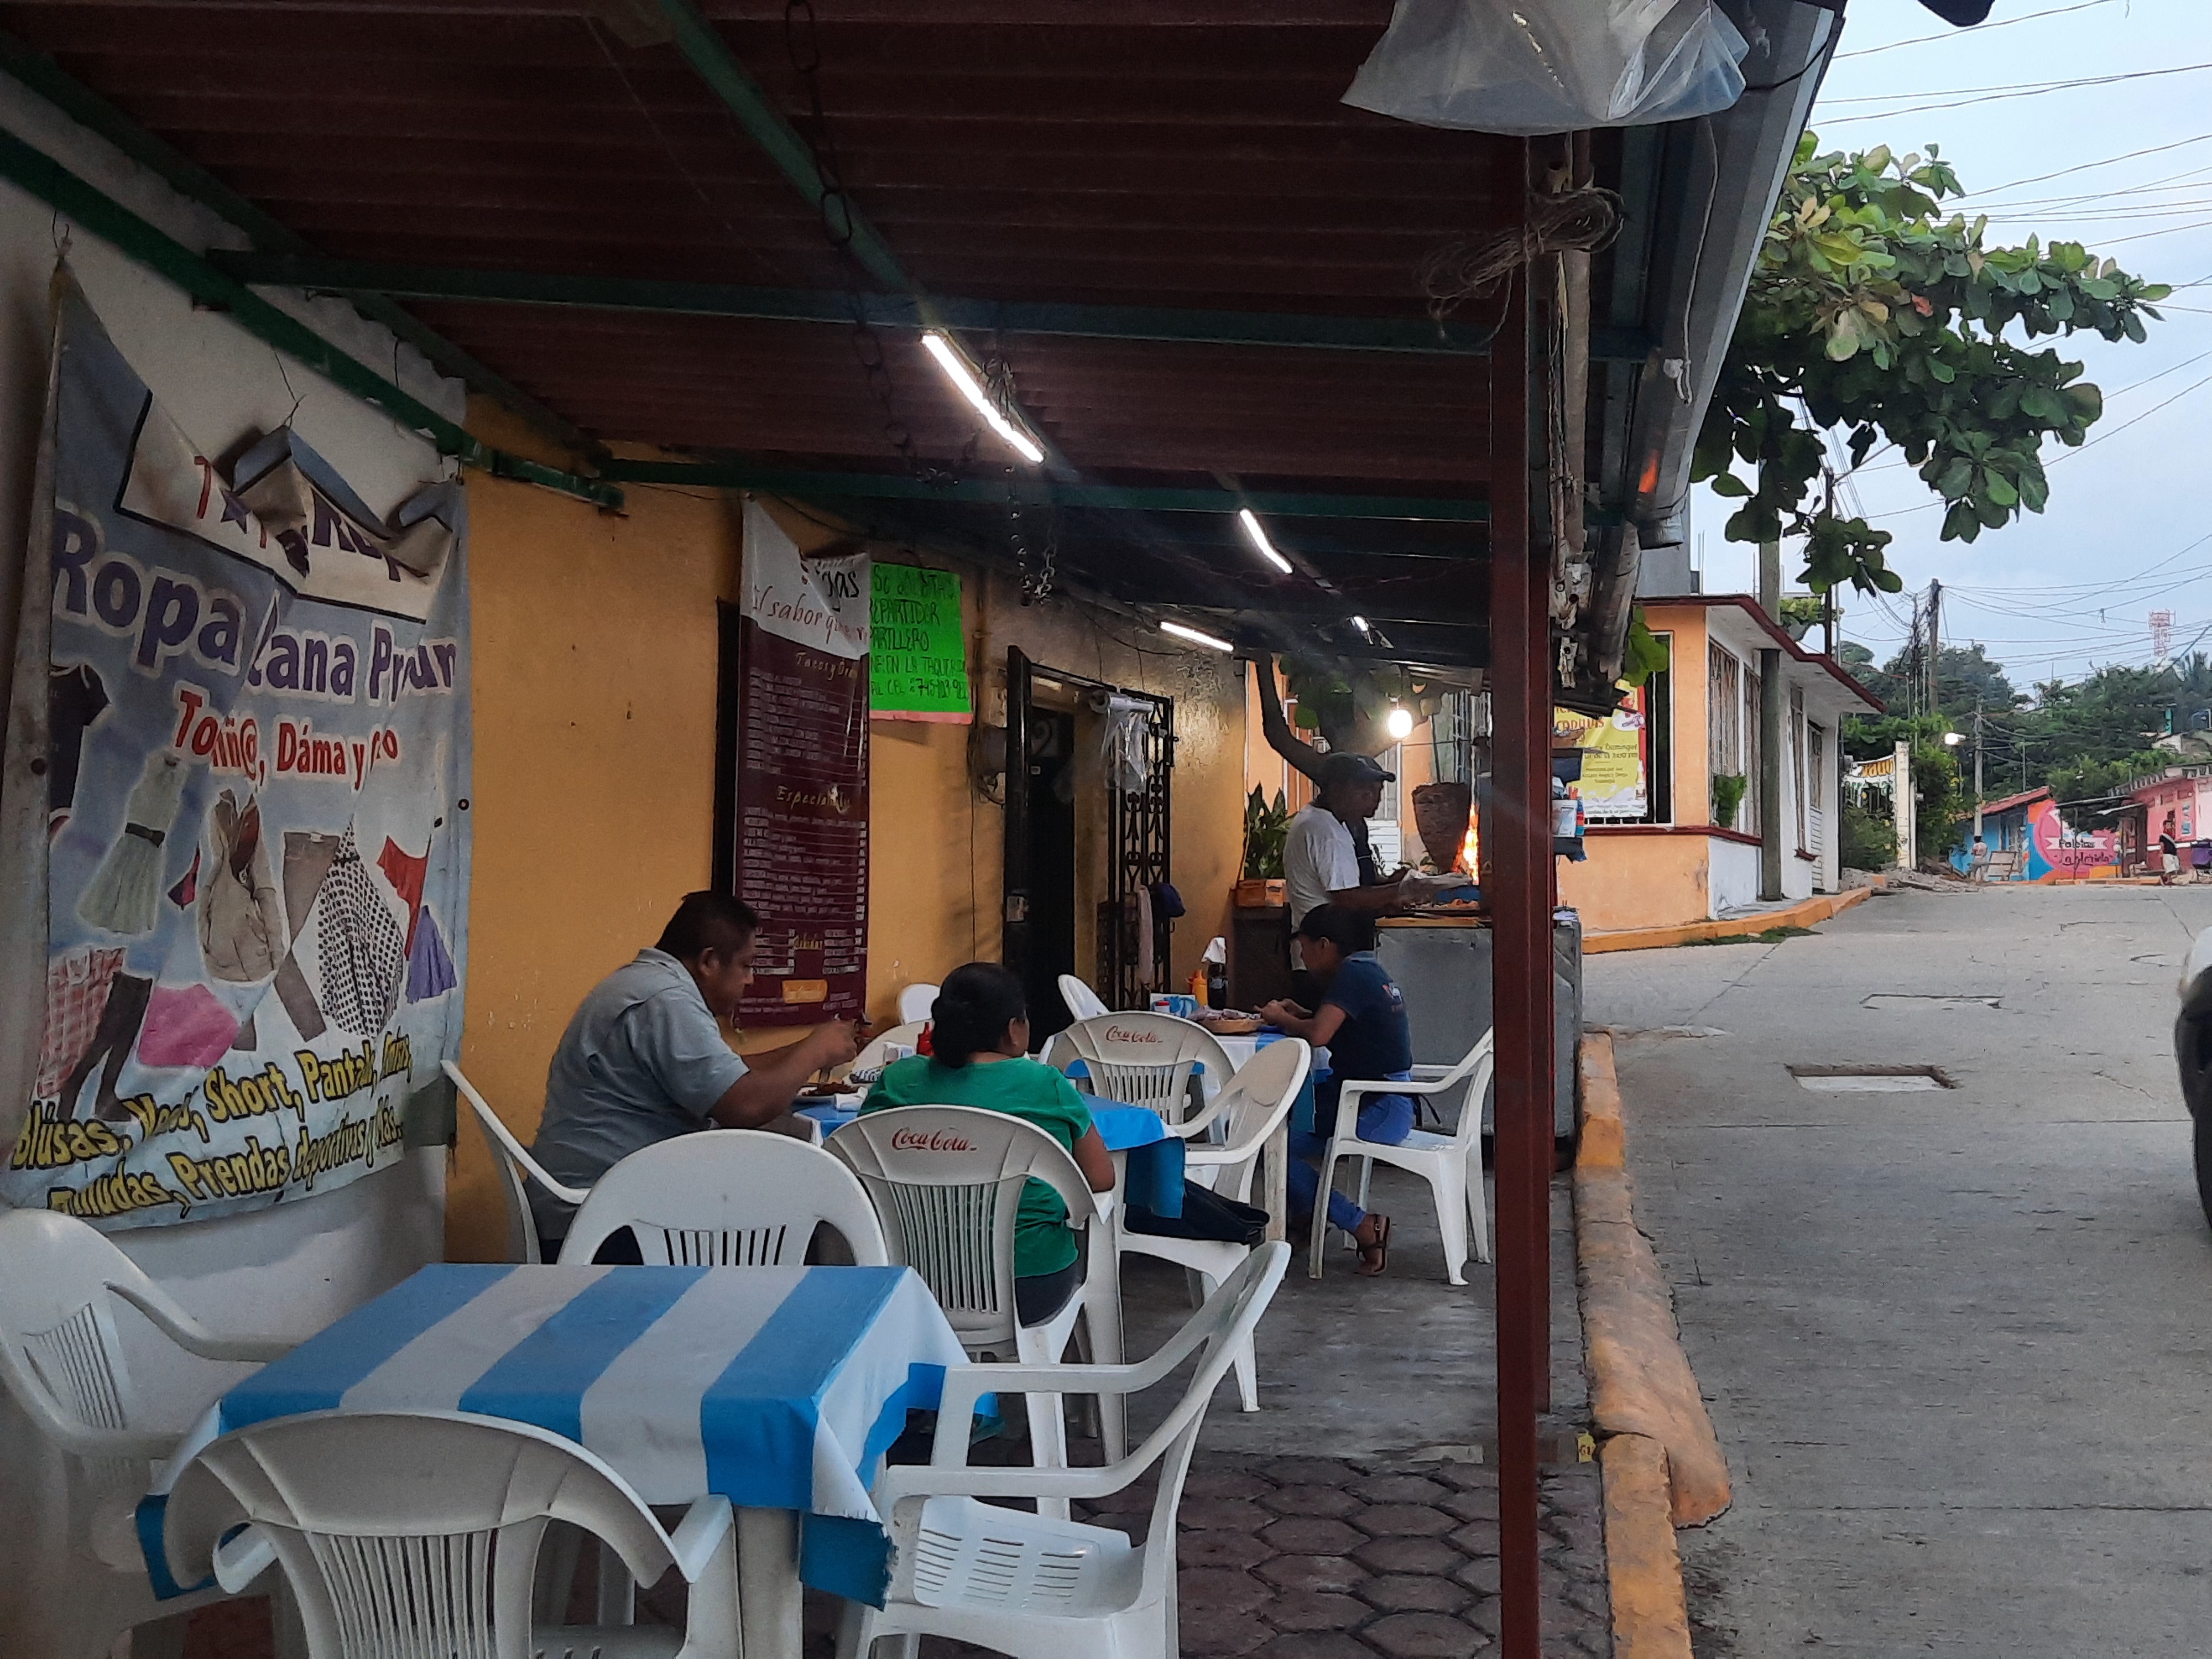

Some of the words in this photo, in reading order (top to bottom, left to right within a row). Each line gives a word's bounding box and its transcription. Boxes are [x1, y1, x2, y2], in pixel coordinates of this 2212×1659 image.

[53, 511, 241, 668] Ropa
[768, 593, 823, 625] sabor
[276, 722, 346, 775] Dáma
[352, 743, 365, 791] y
[204, 1061, 306, 1123] Short,
[165, 1135, 291, 1201] Prendas
[292, 1110, 367, 1192] deportivas
